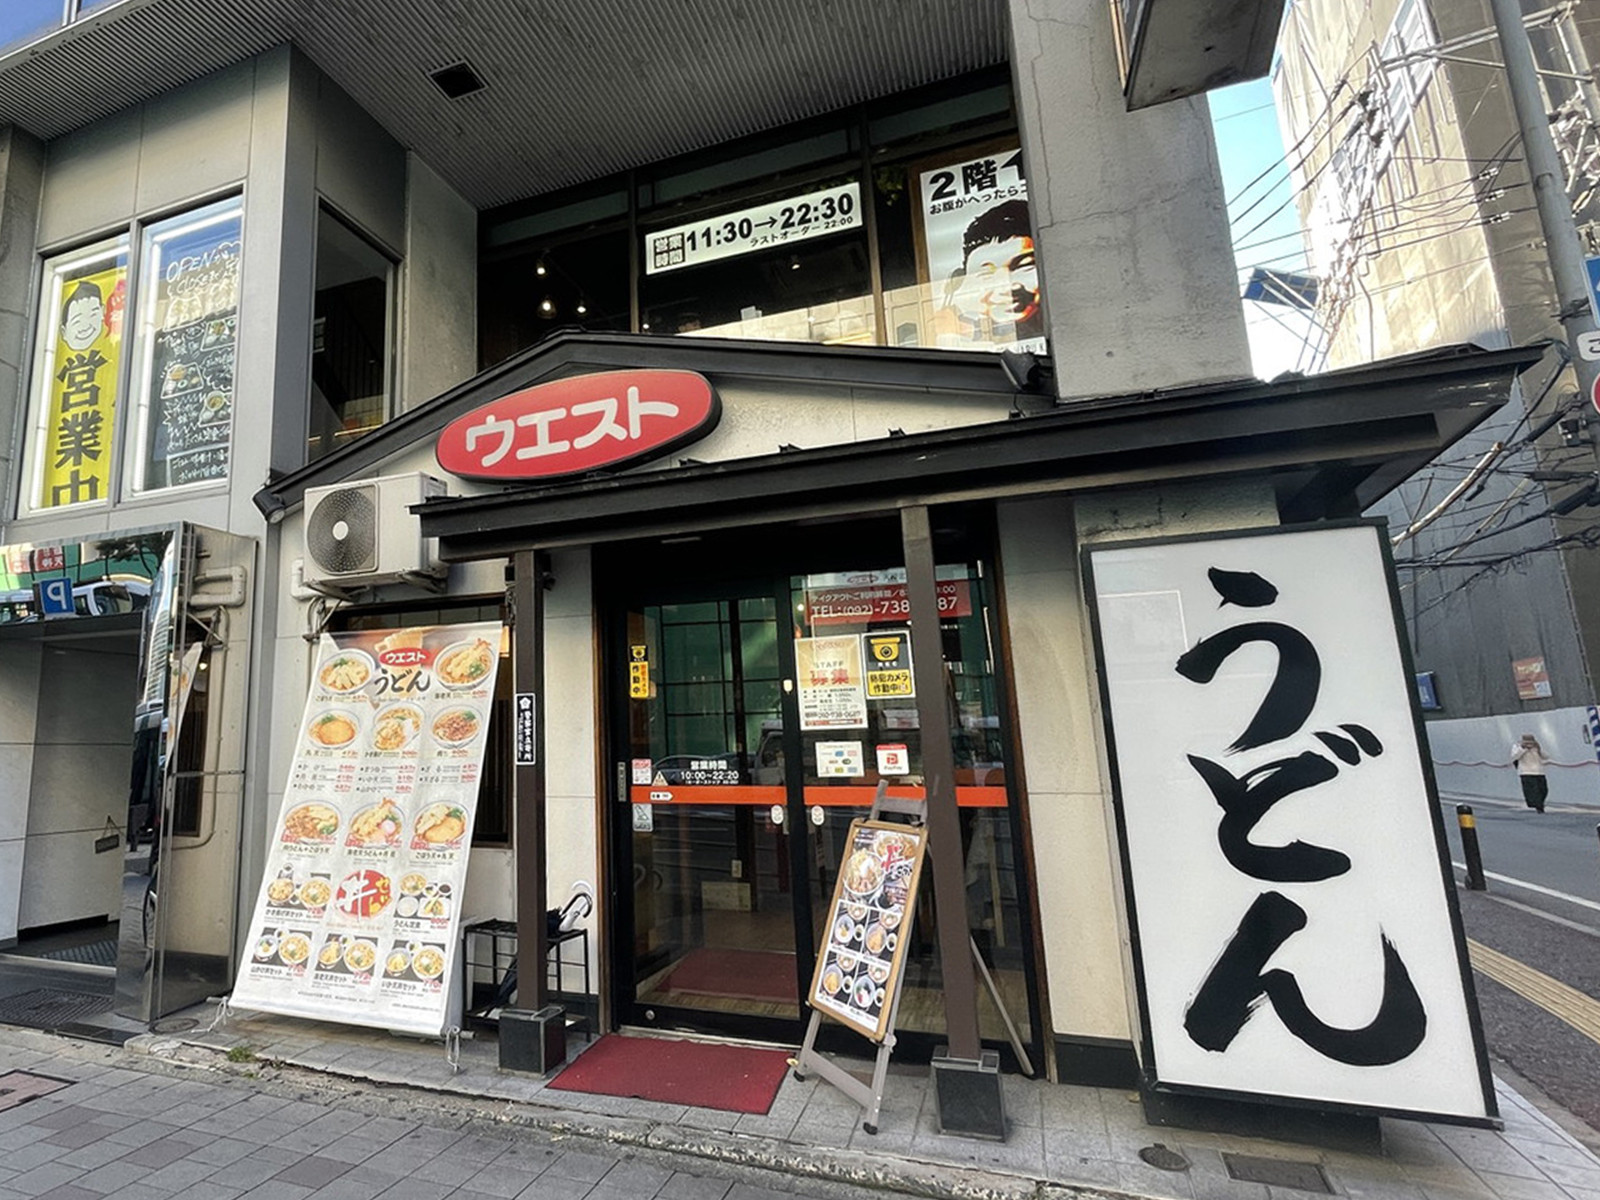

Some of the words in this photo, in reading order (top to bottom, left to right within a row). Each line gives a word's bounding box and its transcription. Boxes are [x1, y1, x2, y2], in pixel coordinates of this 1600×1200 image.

[929, 159, 998, 202] 2階
[686, 217, 753, 252] 11:30
[780, 193, 854, 230] 22:30
[824, 215, 854, 229] 22:00
[52, 349, 108, 506] 営業中
[465, 386, 679, 468] ウエスト
[385, 650, 426, 664] ウエスト
[373, 667, 431, 696] うどん
[870, 672, 909, 683] 防犯カメラ
[872, 683, 899, 694] 作動中
[690, 759, 728, 770] 営業時間
[1175, 566, 1427, 1067] うどん
